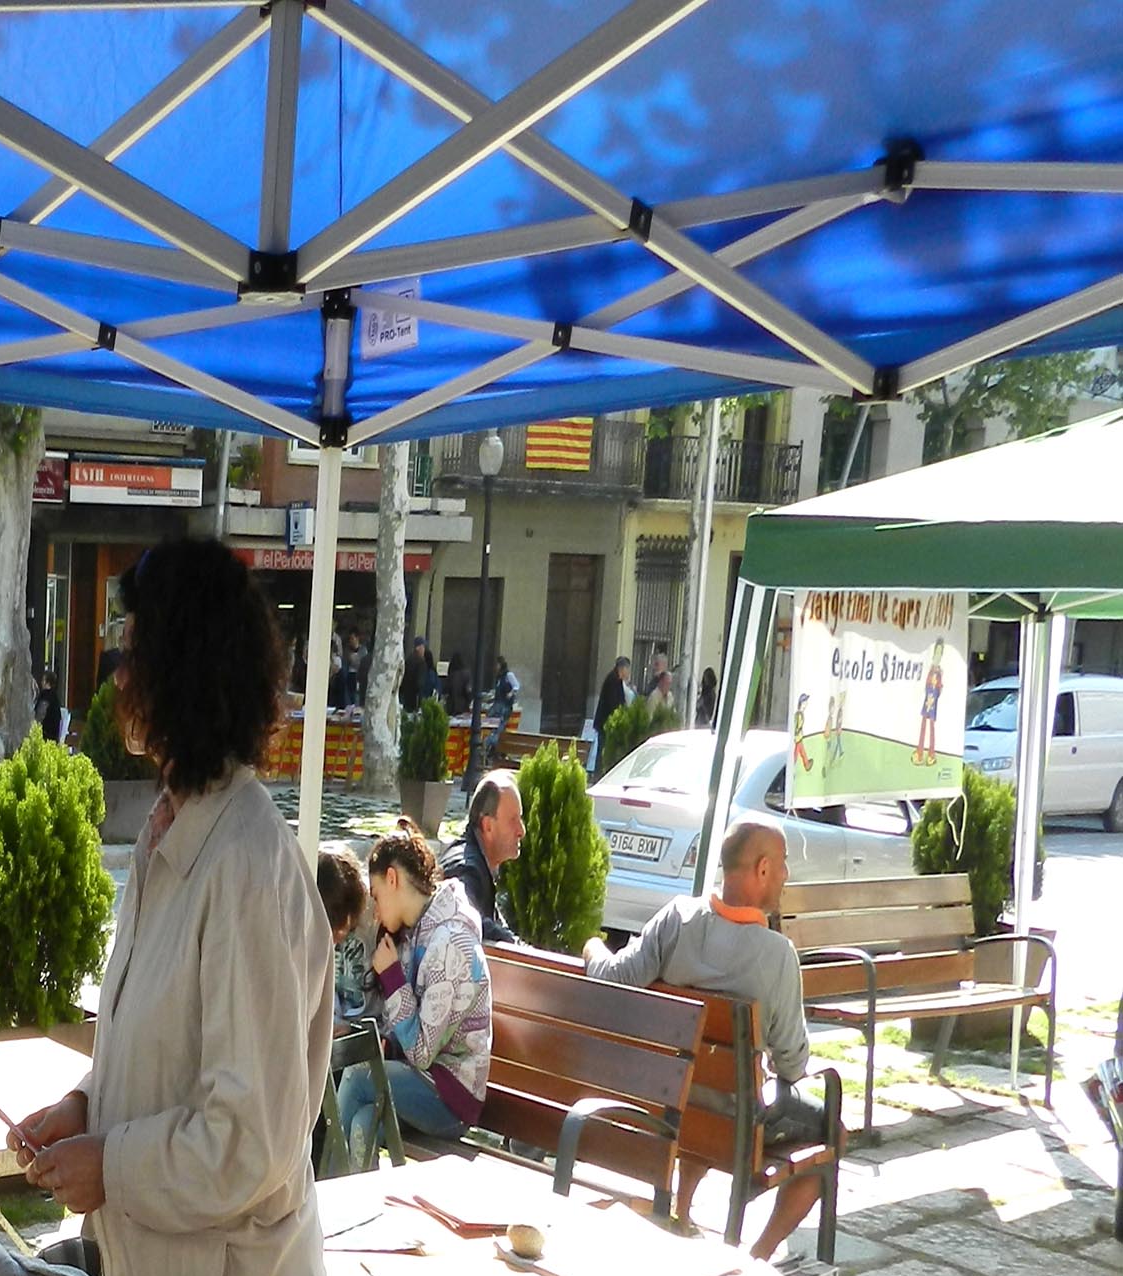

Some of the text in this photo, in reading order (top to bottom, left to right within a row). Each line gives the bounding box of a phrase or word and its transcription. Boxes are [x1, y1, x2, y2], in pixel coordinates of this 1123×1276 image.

[380, 325, 411, 343] PRO-Tent
[264, 551, 274, 569] el
[348, 555, 358, 570] el
[610, 834, 634, 851] 9164
